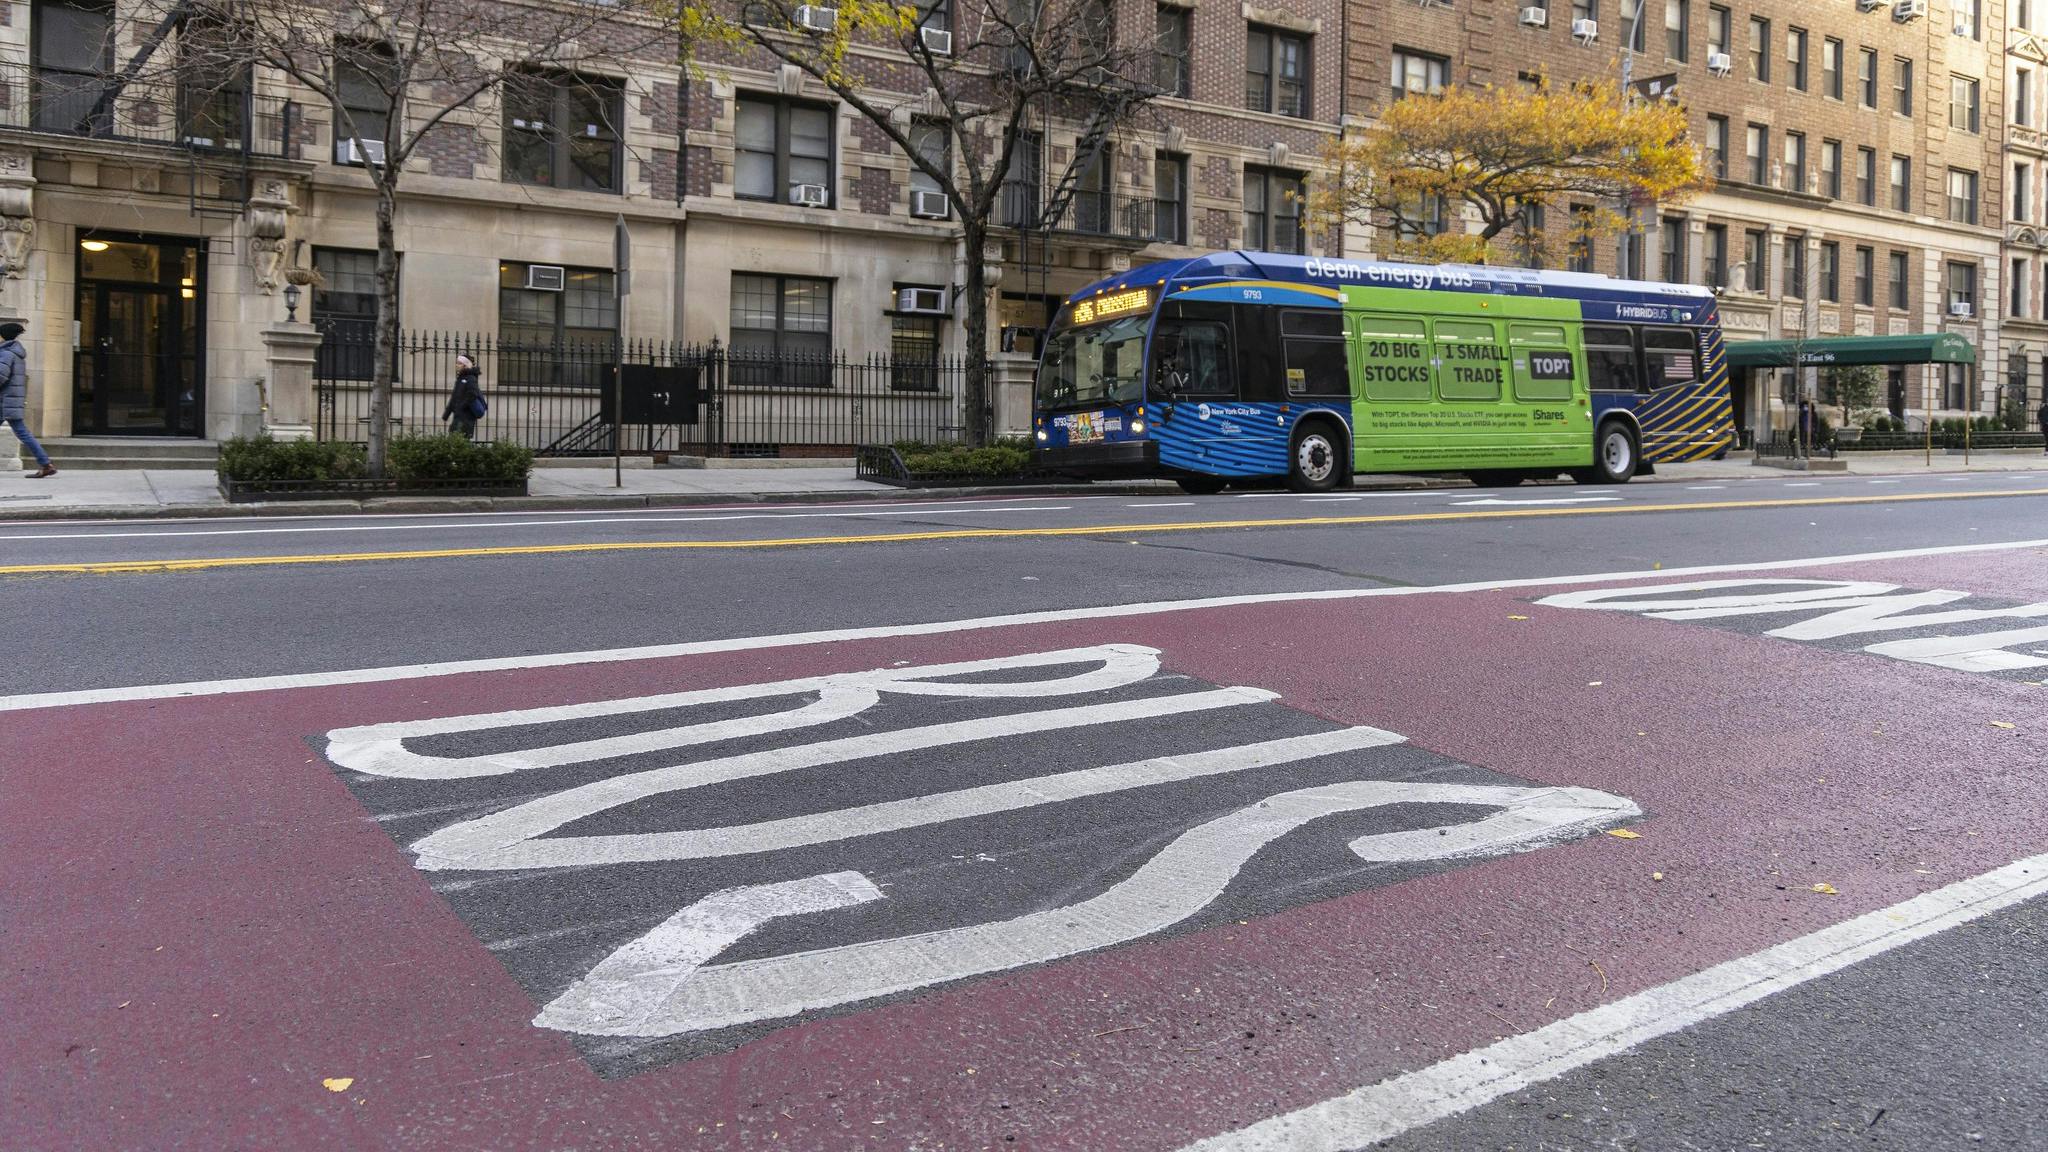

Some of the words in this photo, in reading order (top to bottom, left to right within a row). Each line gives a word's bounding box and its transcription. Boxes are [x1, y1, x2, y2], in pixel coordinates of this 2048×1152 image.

[1305, 258, 1434, 289] clean-energy
[1438, 267, 1473, 287] bus
[1243, 289, 1262, 300] 9793
[1369, 341, 1389, 358] 20
[1393, 342, 1420, 358] BIG
[1445, 344, 1454, 359] 1
[1457, 344, 1508, 361] SMALL
[1365, 365, 1429, 382] STOCKS
[1533, 358, 1570, 374] TOPT
[1453, 367, 1504, 383] TRADE
[1238, 408, 1249, 416] City
